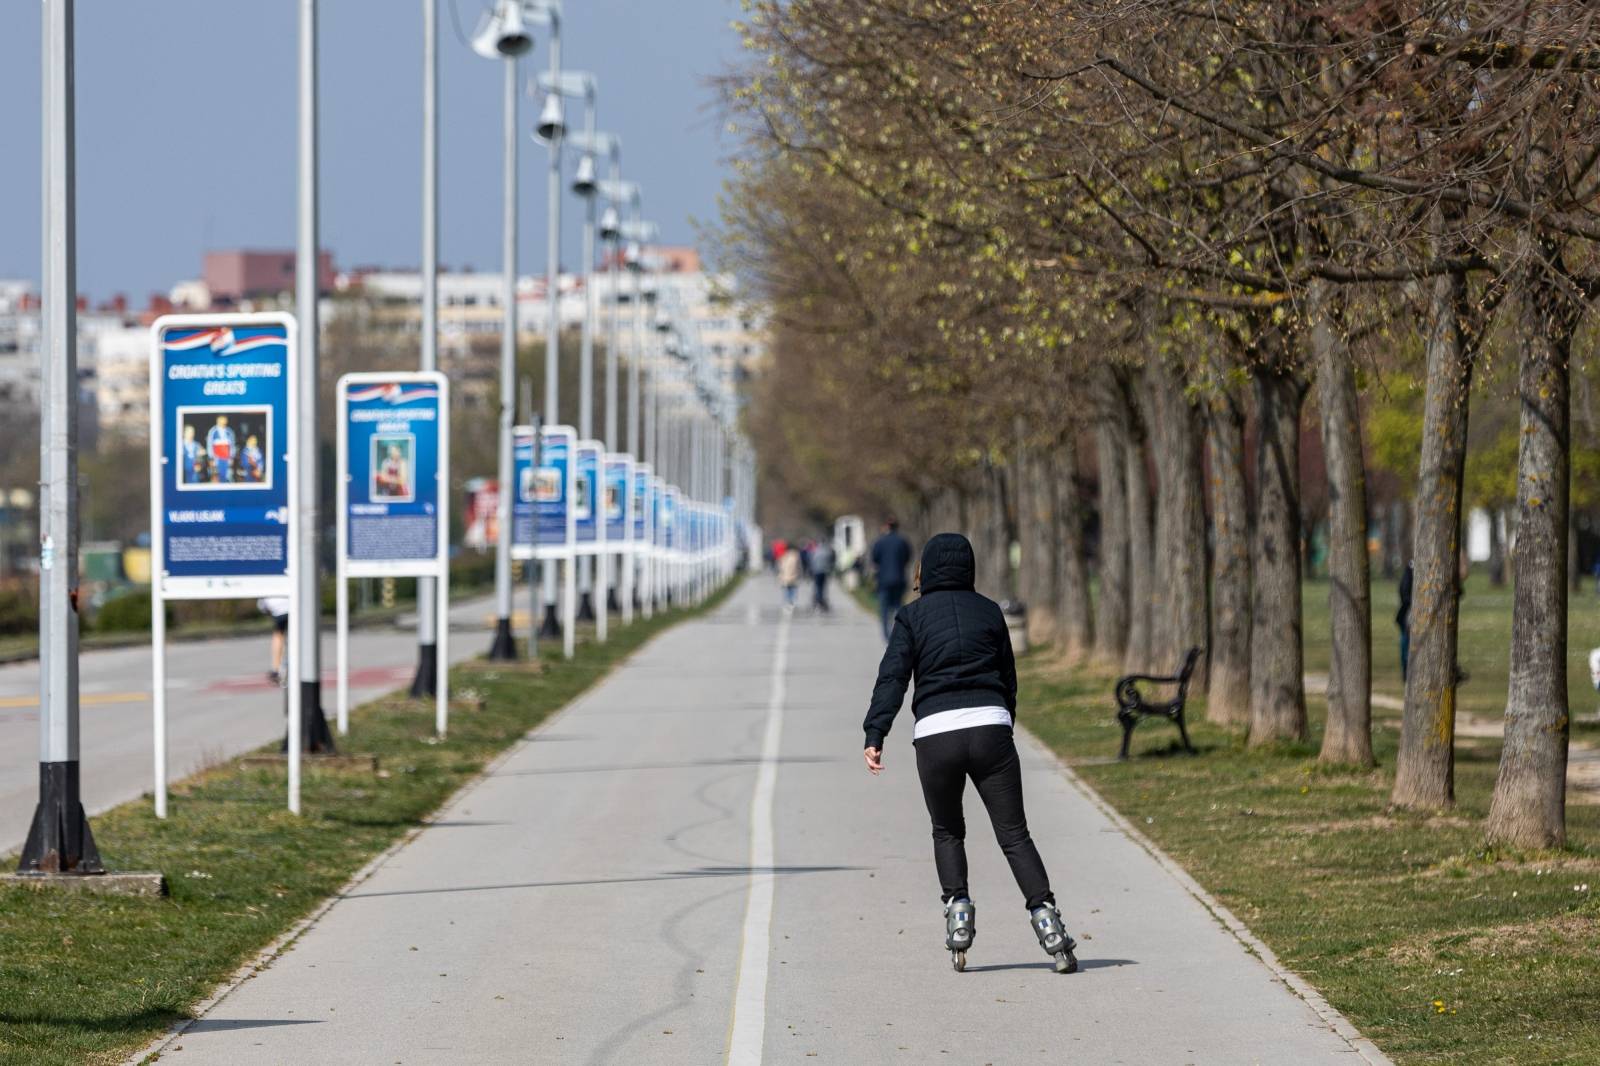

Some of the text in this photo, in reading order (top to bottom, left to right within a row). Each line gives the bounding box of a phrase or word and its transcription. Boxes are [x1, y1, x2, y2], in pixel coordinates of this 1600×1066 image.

[168, 362, 282, 379] CROATIA'S SPORTING
[203, 380, 247, 395] GREATS
